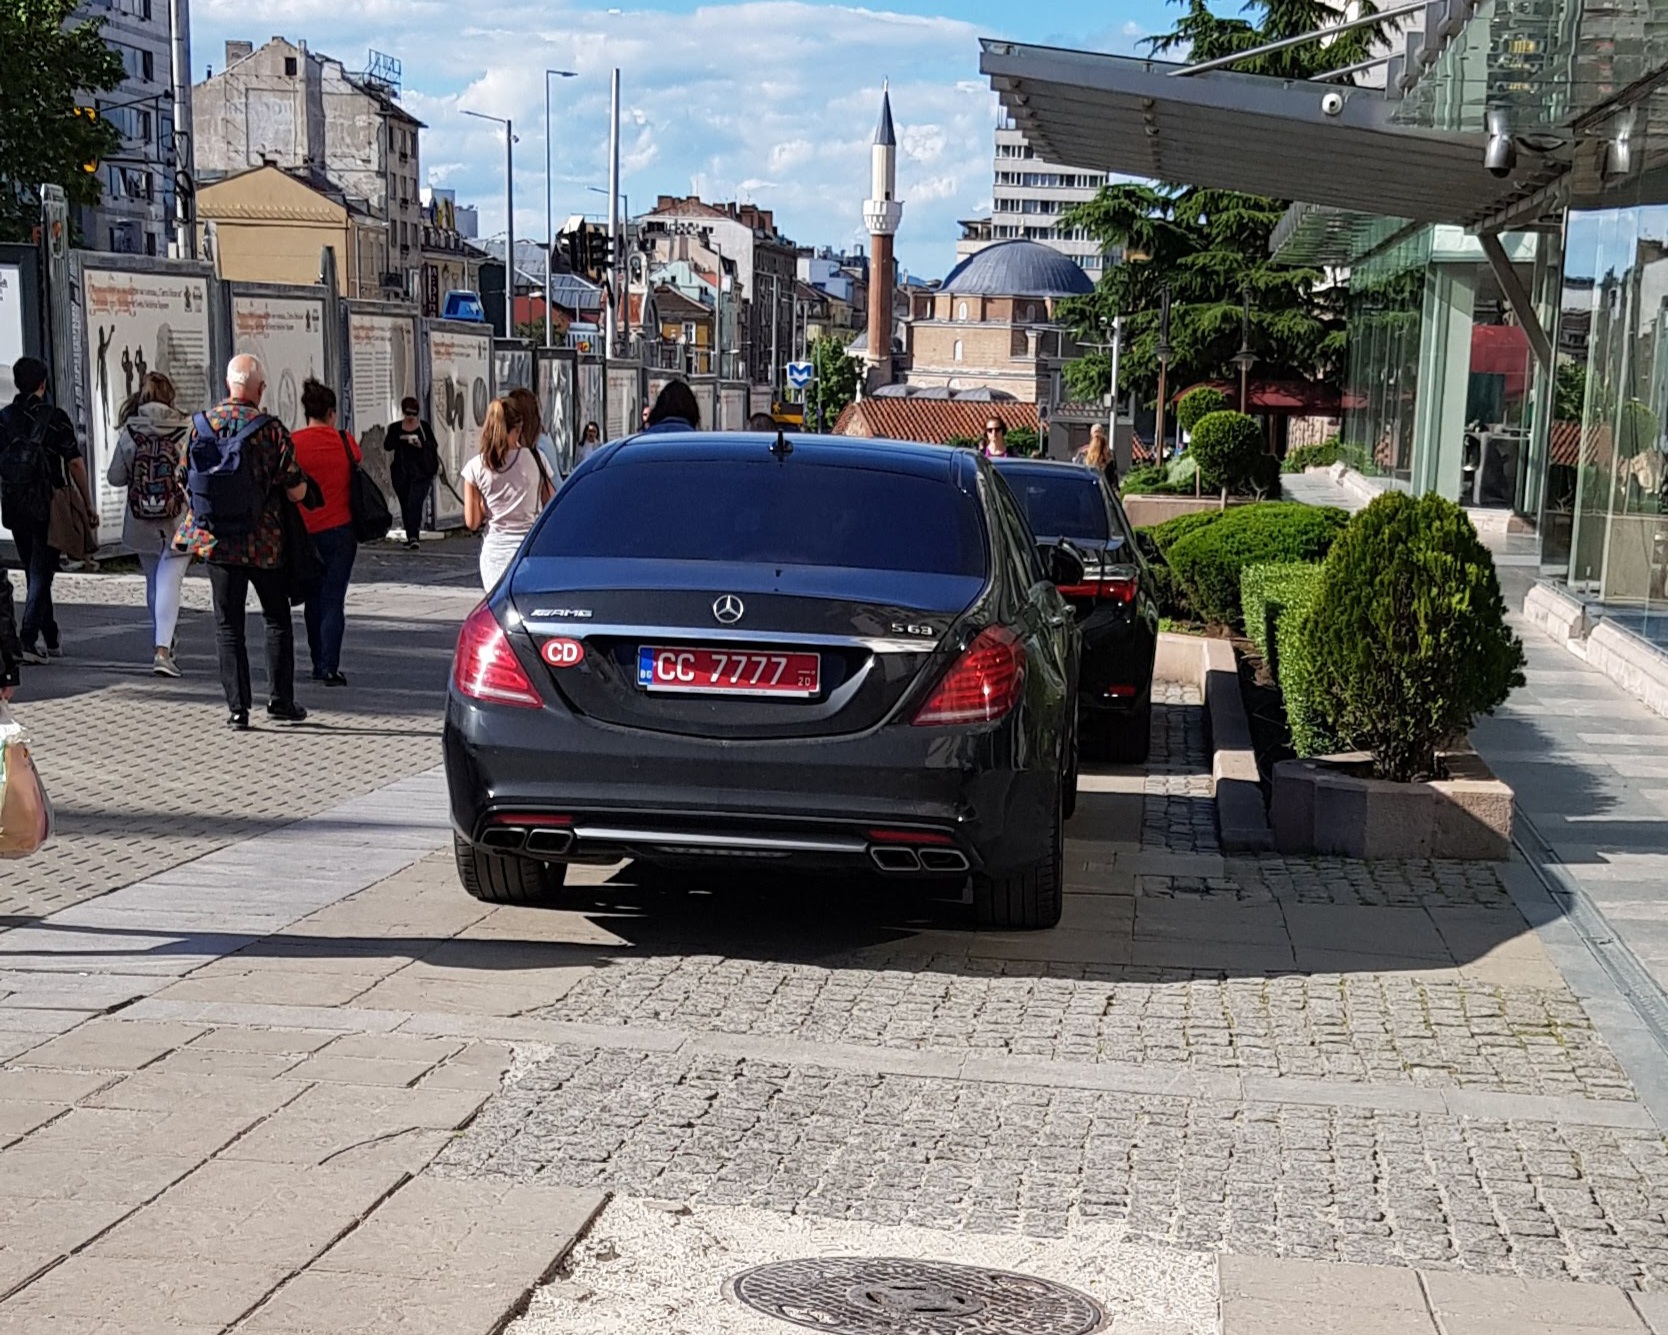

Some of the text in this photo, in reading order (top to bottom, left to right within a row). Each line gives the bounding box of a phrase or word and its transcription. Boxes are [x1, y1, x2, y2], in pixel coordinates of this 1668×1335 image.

[891, 623, 933, 637] S 63
[547, 641, 579, 663] CD
[640, 669, 653, 680] BG
[657, 652, 788, 686] CC 7777
[797, 677, 811, 687] 20
